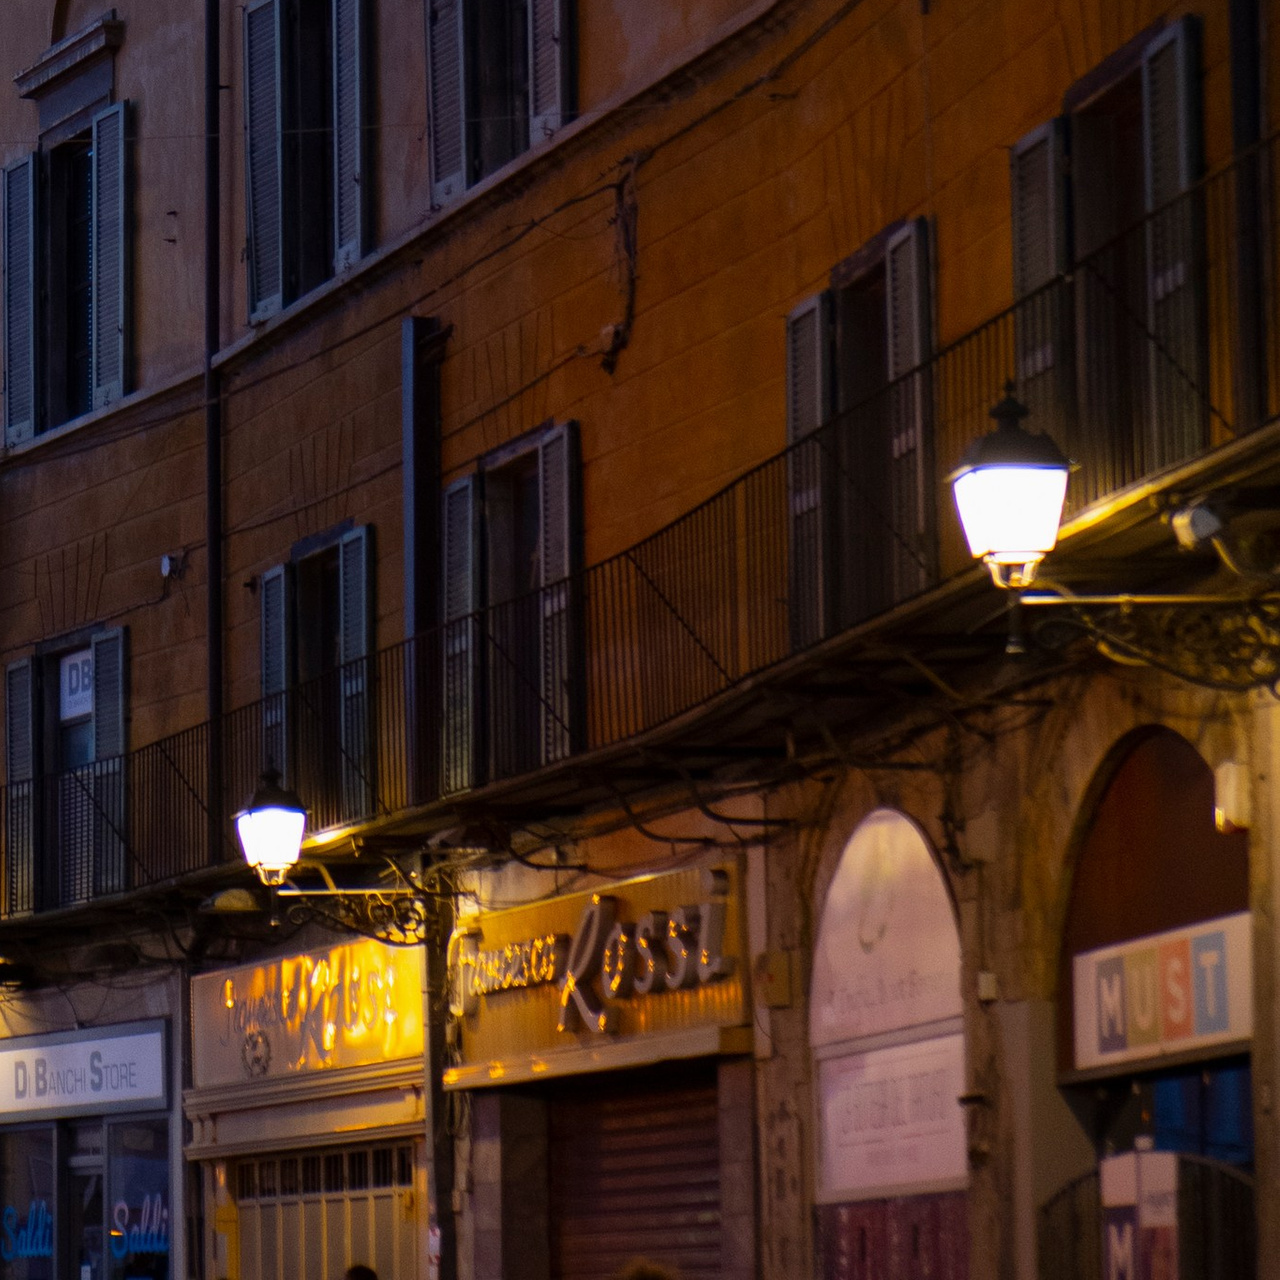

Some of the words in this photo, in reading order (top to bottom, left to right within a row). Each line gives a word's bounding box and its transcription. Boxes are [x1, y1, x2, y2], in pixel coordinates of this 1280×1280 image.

[557, 869, 722, 1032] Rossi
[1100, 951, 1219, 1037] MUST
[1, 1200, 52, 1261] Saldi
[111, 1193, 168, 1259] Saldi
